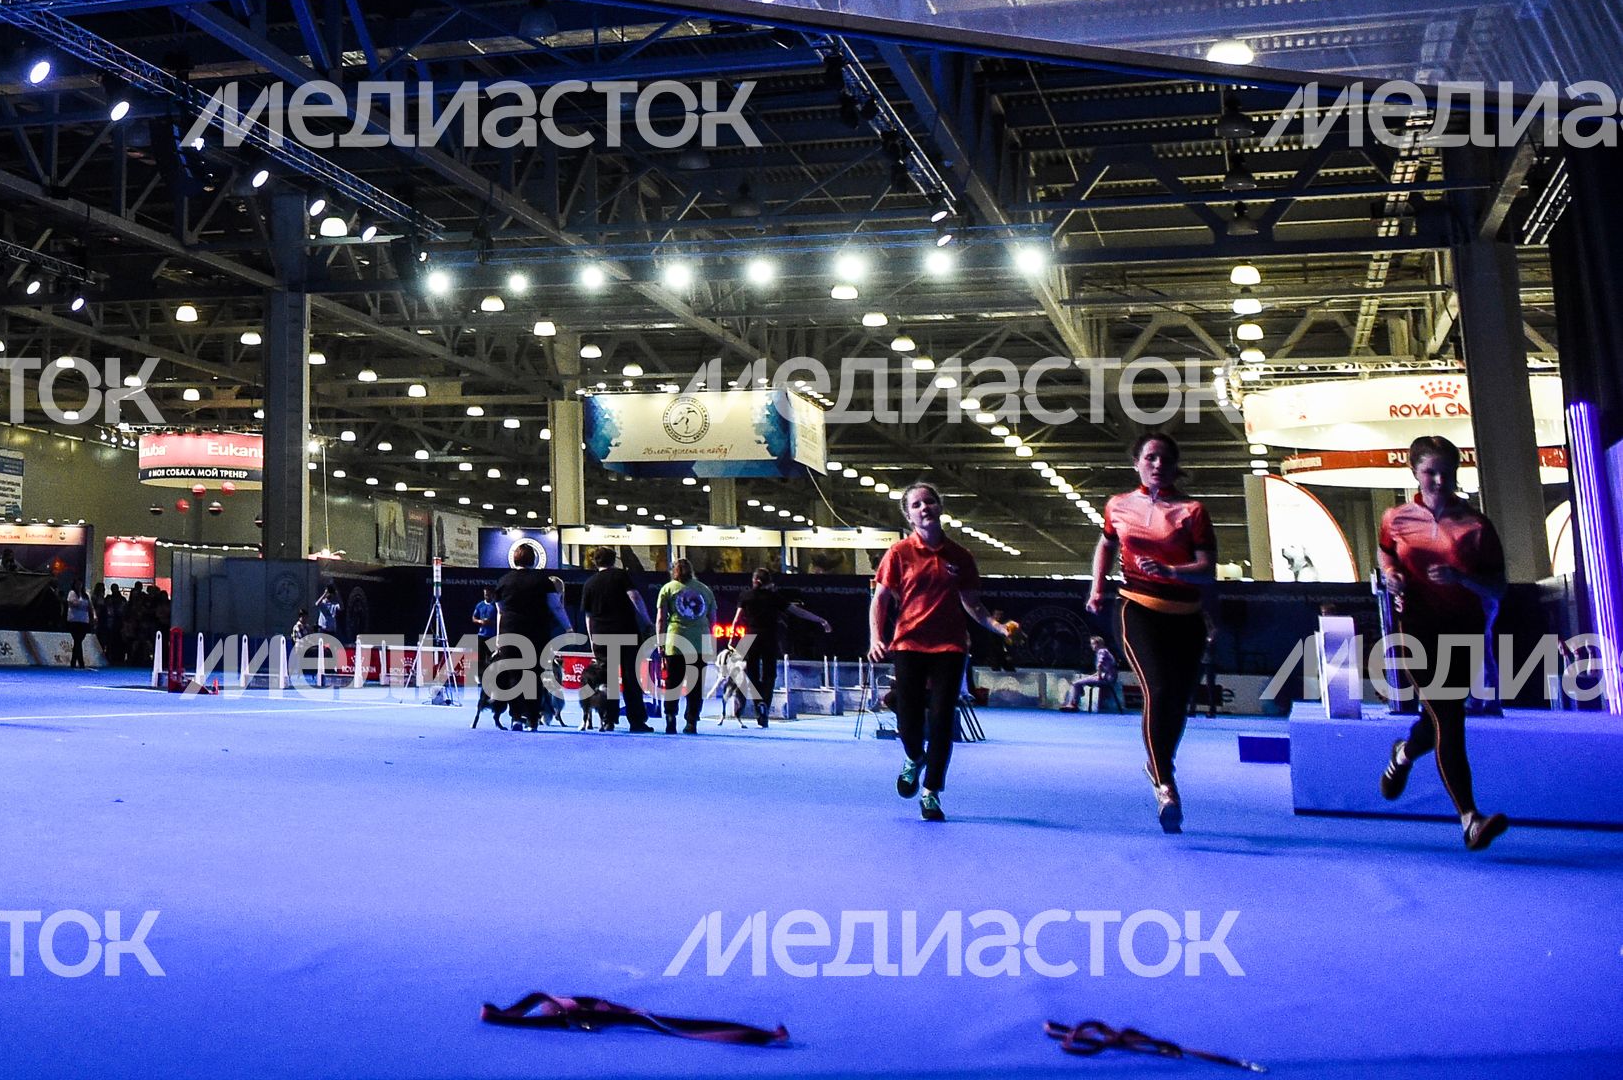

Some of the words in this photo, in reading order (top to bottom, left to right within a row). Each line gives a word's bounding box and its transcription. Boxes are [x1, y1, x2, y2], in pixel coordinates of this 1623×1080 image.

[1390, 403, 1440, 418] ROYAL
[1445, 402, 1470, 417] CA
[1388, 452, 1409, 464] PU
[166, 468, 195, 477] СОБАКА
[219, 469, 248, 479] ТРЕНЕР
